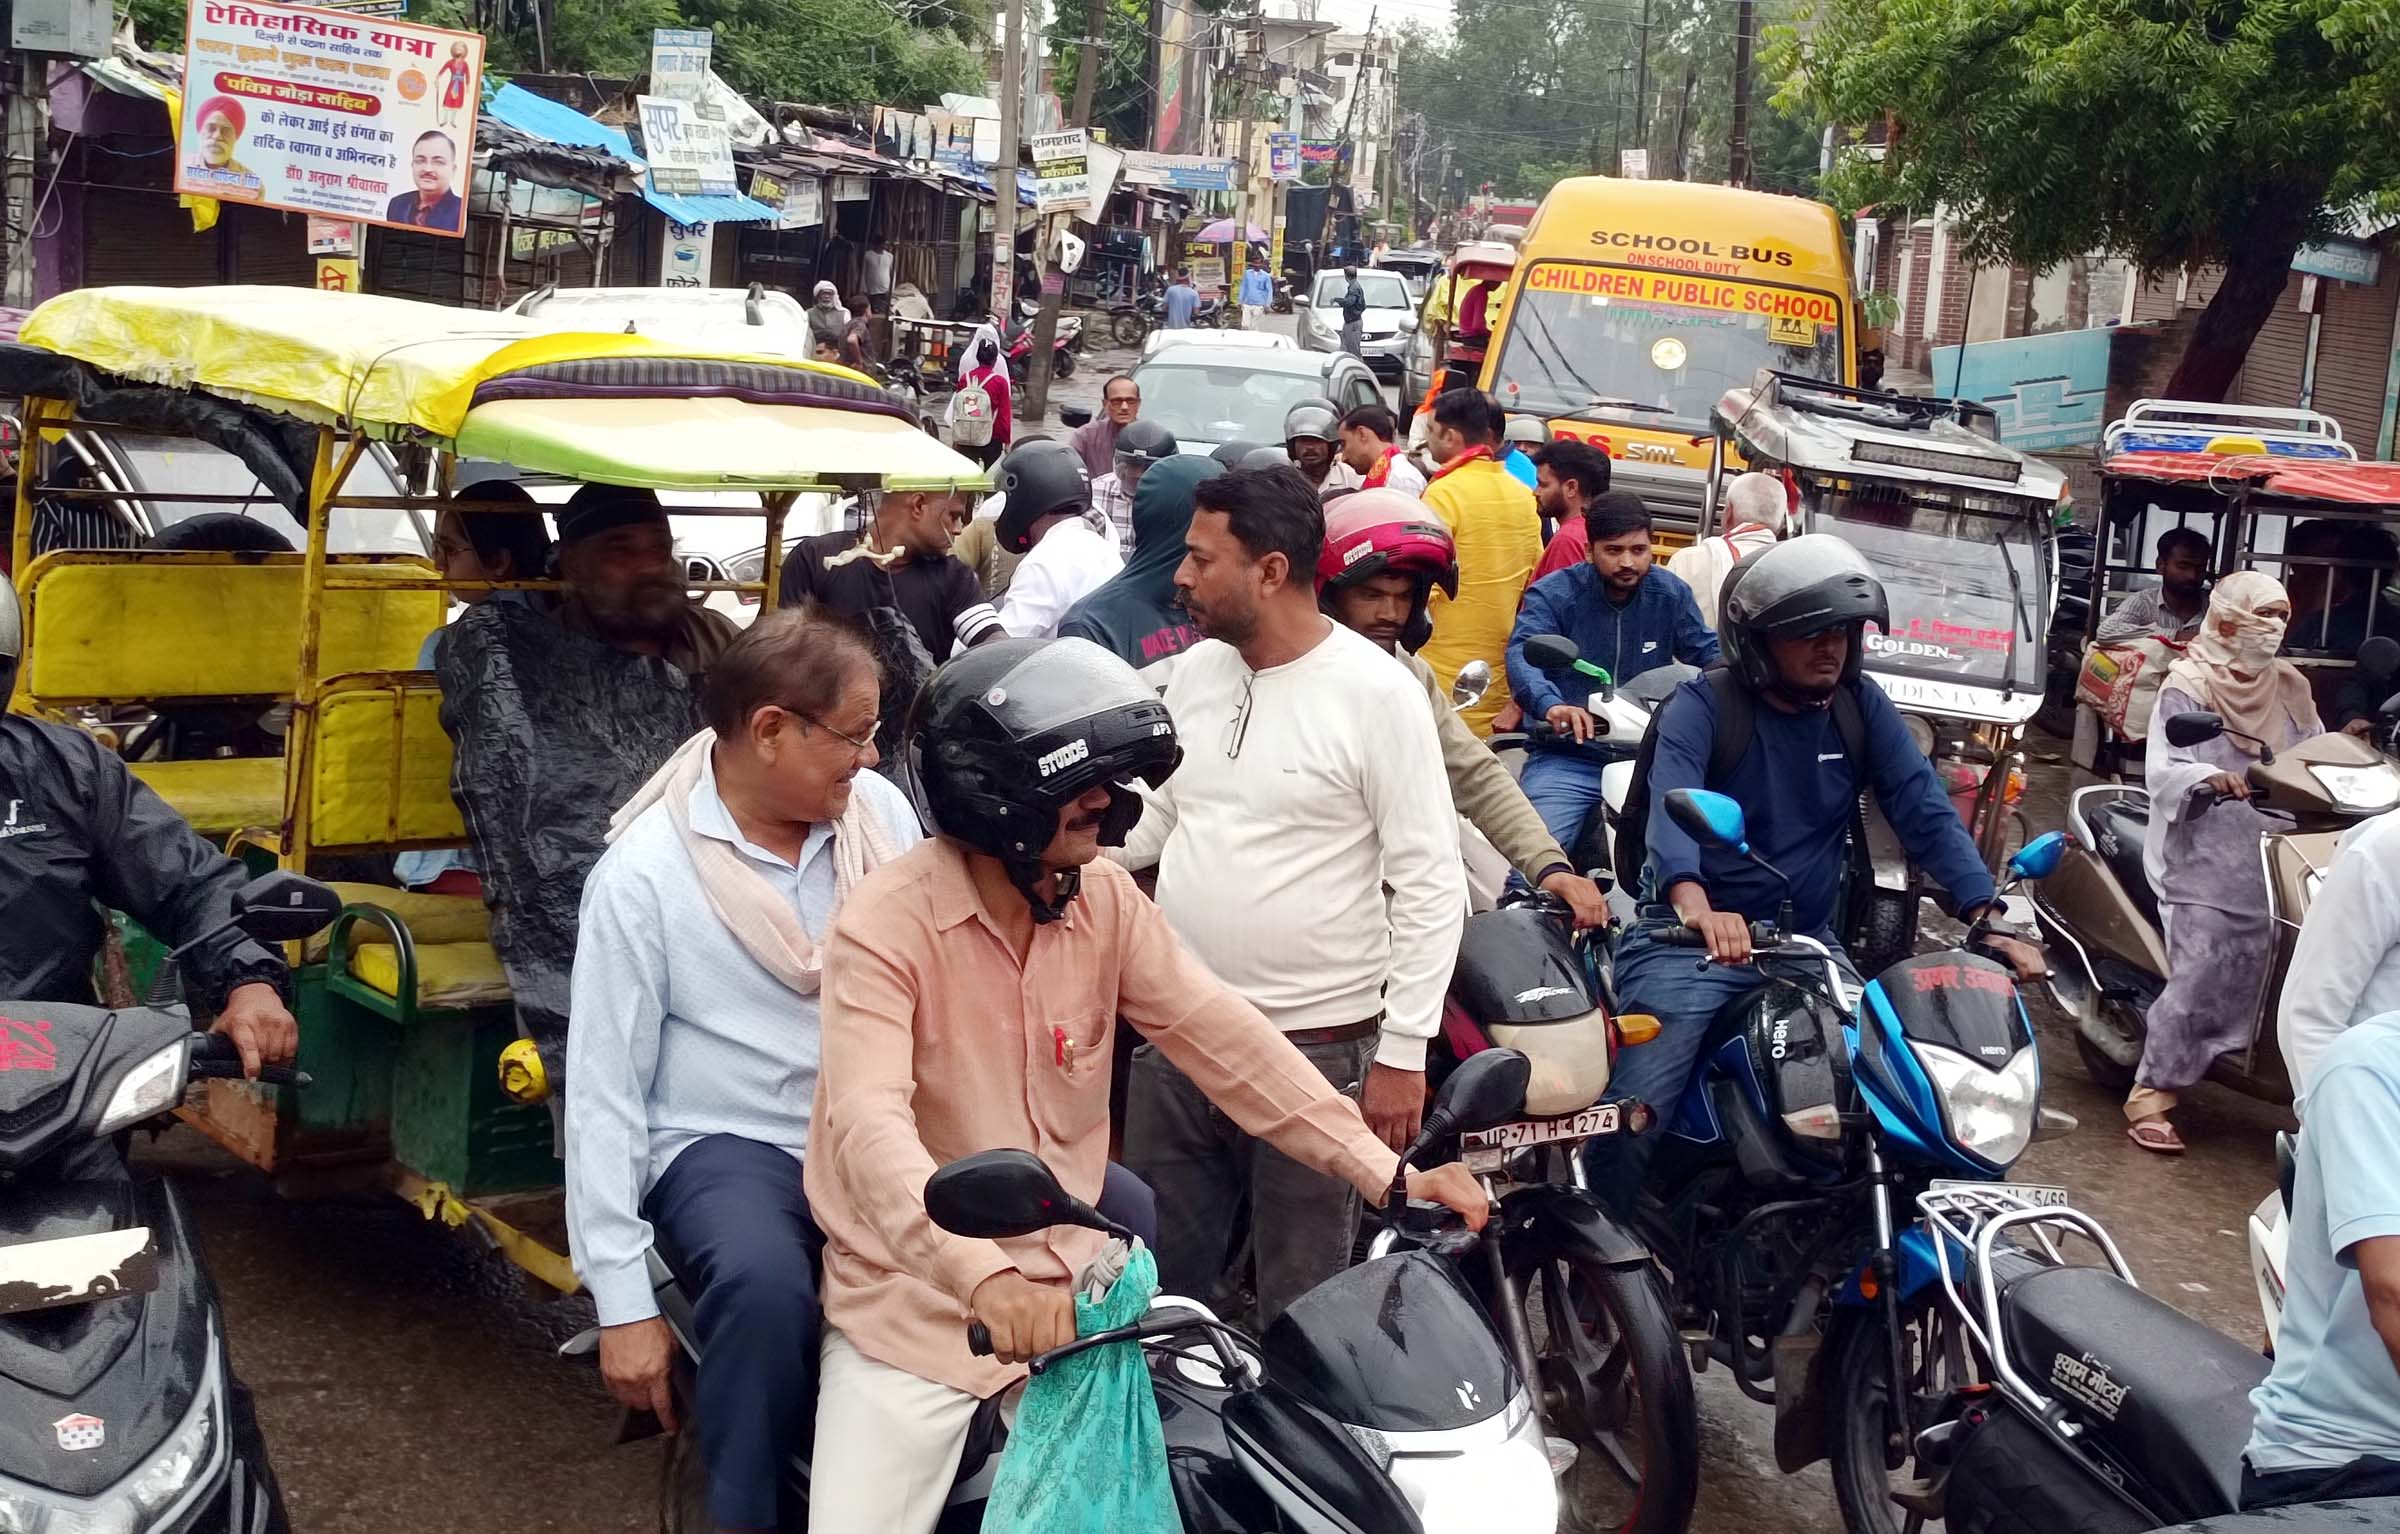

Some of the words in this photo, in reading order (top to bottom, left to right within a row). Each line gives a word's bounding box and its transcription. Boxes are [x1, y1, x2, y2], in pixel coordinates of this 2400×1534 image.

[205, 1, 360, 40] ऐतिहासिक
[369, 31, 437, 59] यात्रा
[255, 29, 284, 43] दिल्ली
[287, 34, 297, 46] से
[329, 42, 361, 56] साहिब
[363, 48, 382, 59] तक
[261, 109, 275, 123] को
[279, 111, 305, 130] लेकर
[308, 118, 330, 135] आई
[332, 120, 347, 139] हुई
[351, 124, 376, 141] संगत
[379, 130, 394, 143] का
[643, 104, 681, 154] सुपर
[1032, 134, 1081, 149] शमशाद
[253, 134, 285, 150] हार्दिक
[289, 141, 322, 157] स्वागत
[325, 146, 332, 159] व
[336, 147, 386, 168] अभिनन्दन
[388, 153, 397, 169] है
[308, 170, 342, 189] अनुराग
[347, 174, 389, 194] श्रीवास्तव
[1590, 230, 1719, 257] SCHOOL
[1731, 245, 1793, 267] BUS
[1627, 252, 1649, 265] ON
[1649, 255, 1702, 272] SCHOOL
[1704, 261, 1741, 275] DUTY
[1530, 267, 1644, 298] CHILDREN
[1652, 279, 1736, 308] PUBLIC
[1743, 290, 1836, 322] SCHOOL
[1866, 634, 1949, 659] GOLDEN
[1038, 738, 1089, 777] STUDDS
[2054, 1352, 2090, 1384] श्याम
[2087, 1369, 2132, 1407] मोटर्स
